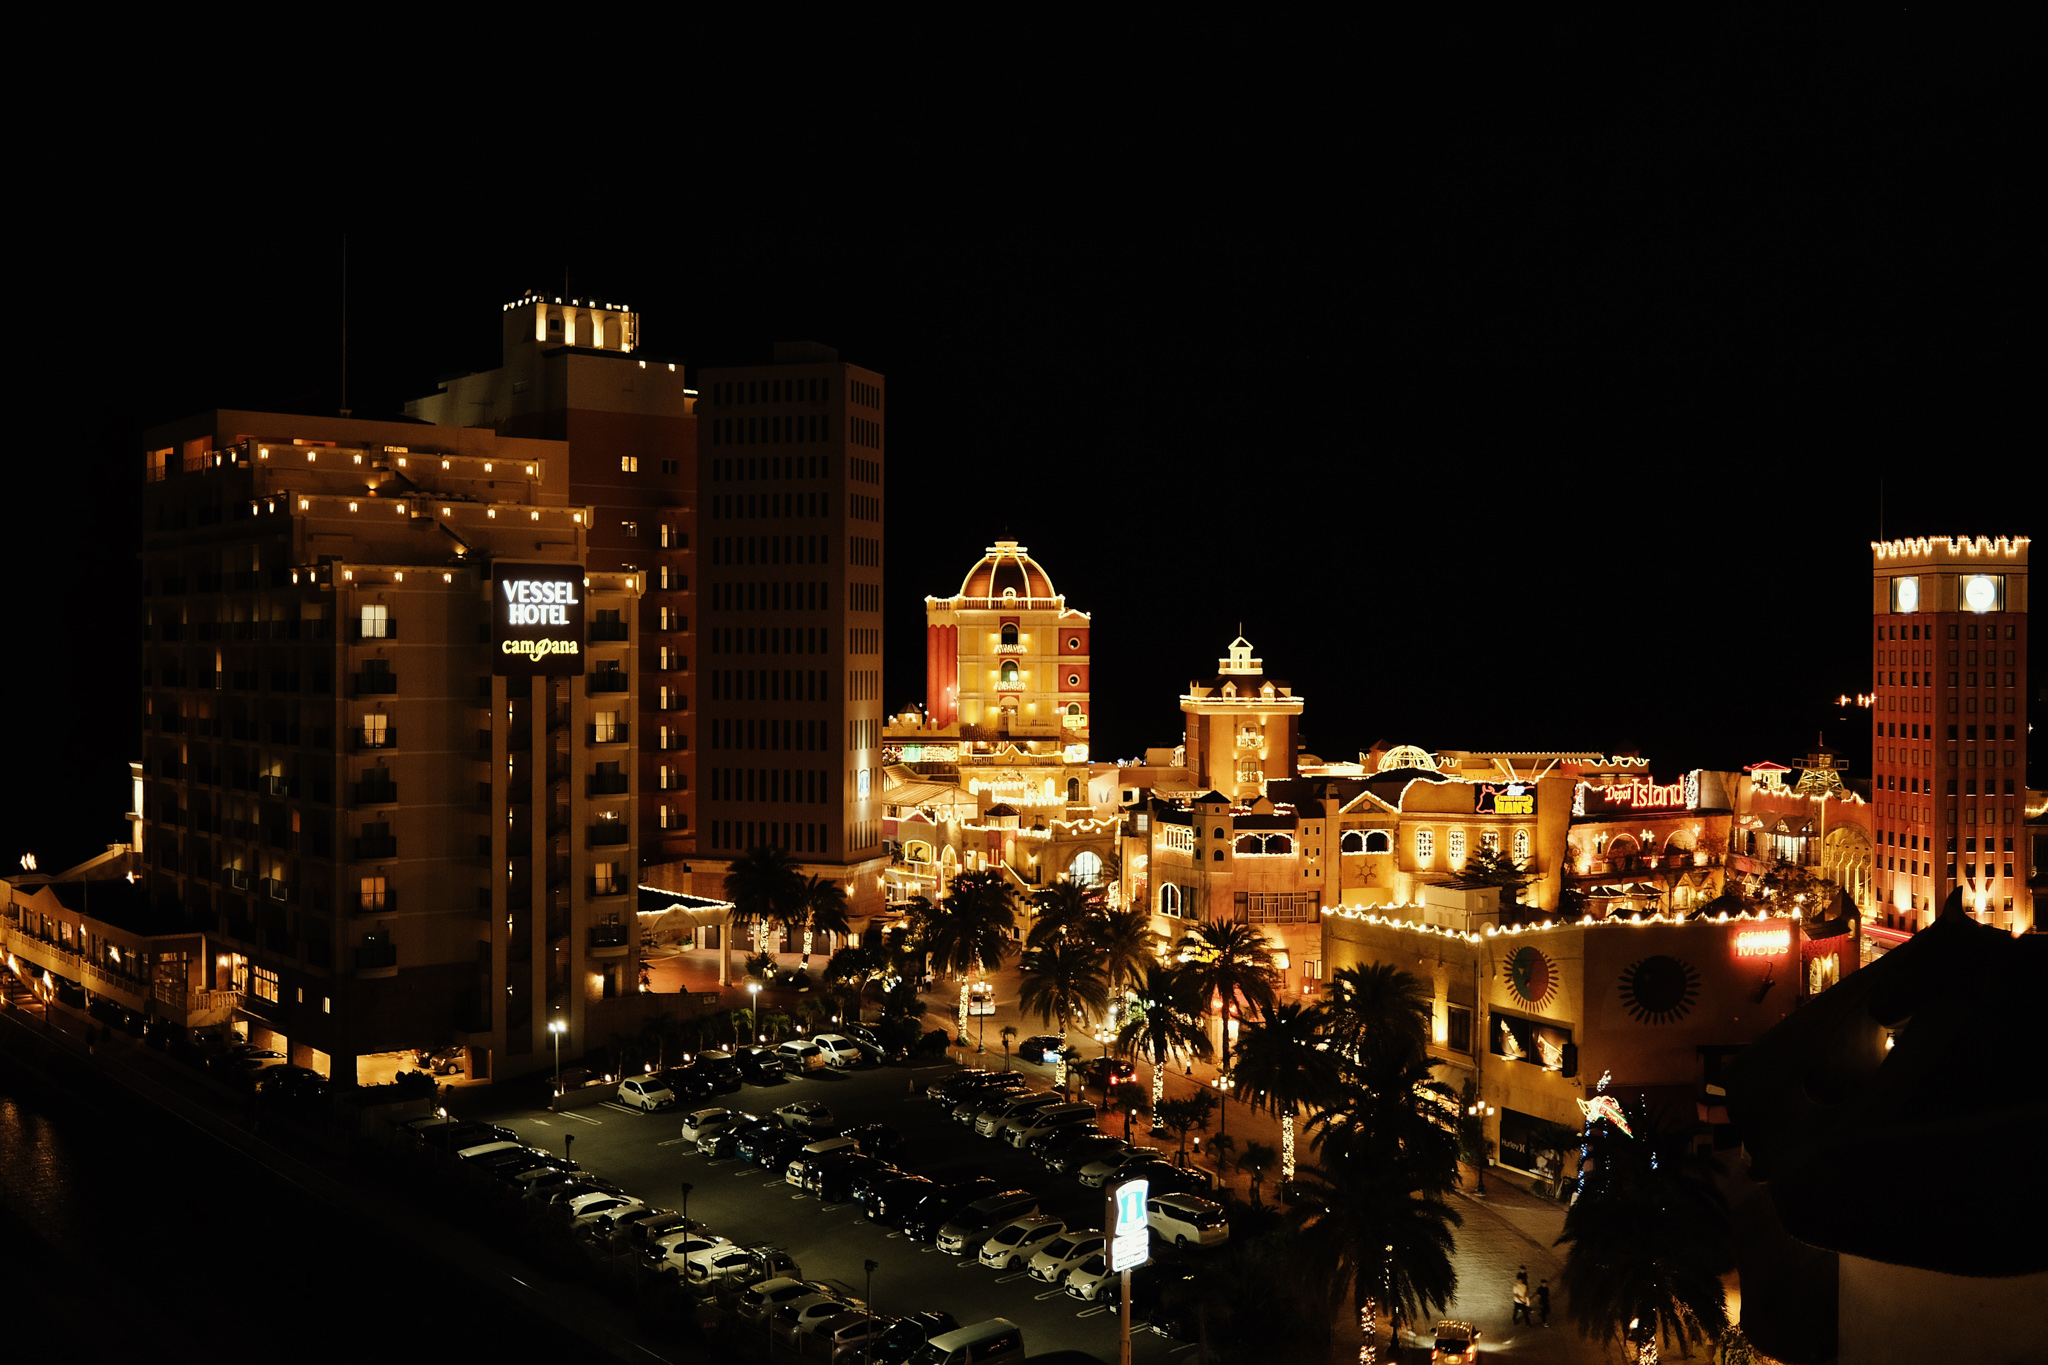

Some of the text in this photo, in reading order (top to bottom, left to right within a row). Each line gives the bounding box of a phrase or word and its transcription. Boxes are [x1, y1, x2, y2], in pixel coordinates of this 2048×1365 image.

[502, 580, 579, 604] VESSEL
[509, 603, 570, 625] HOTEL
[502, 638, 579, 662] campana
[1604, 774, 1684, 807] Depot Island
